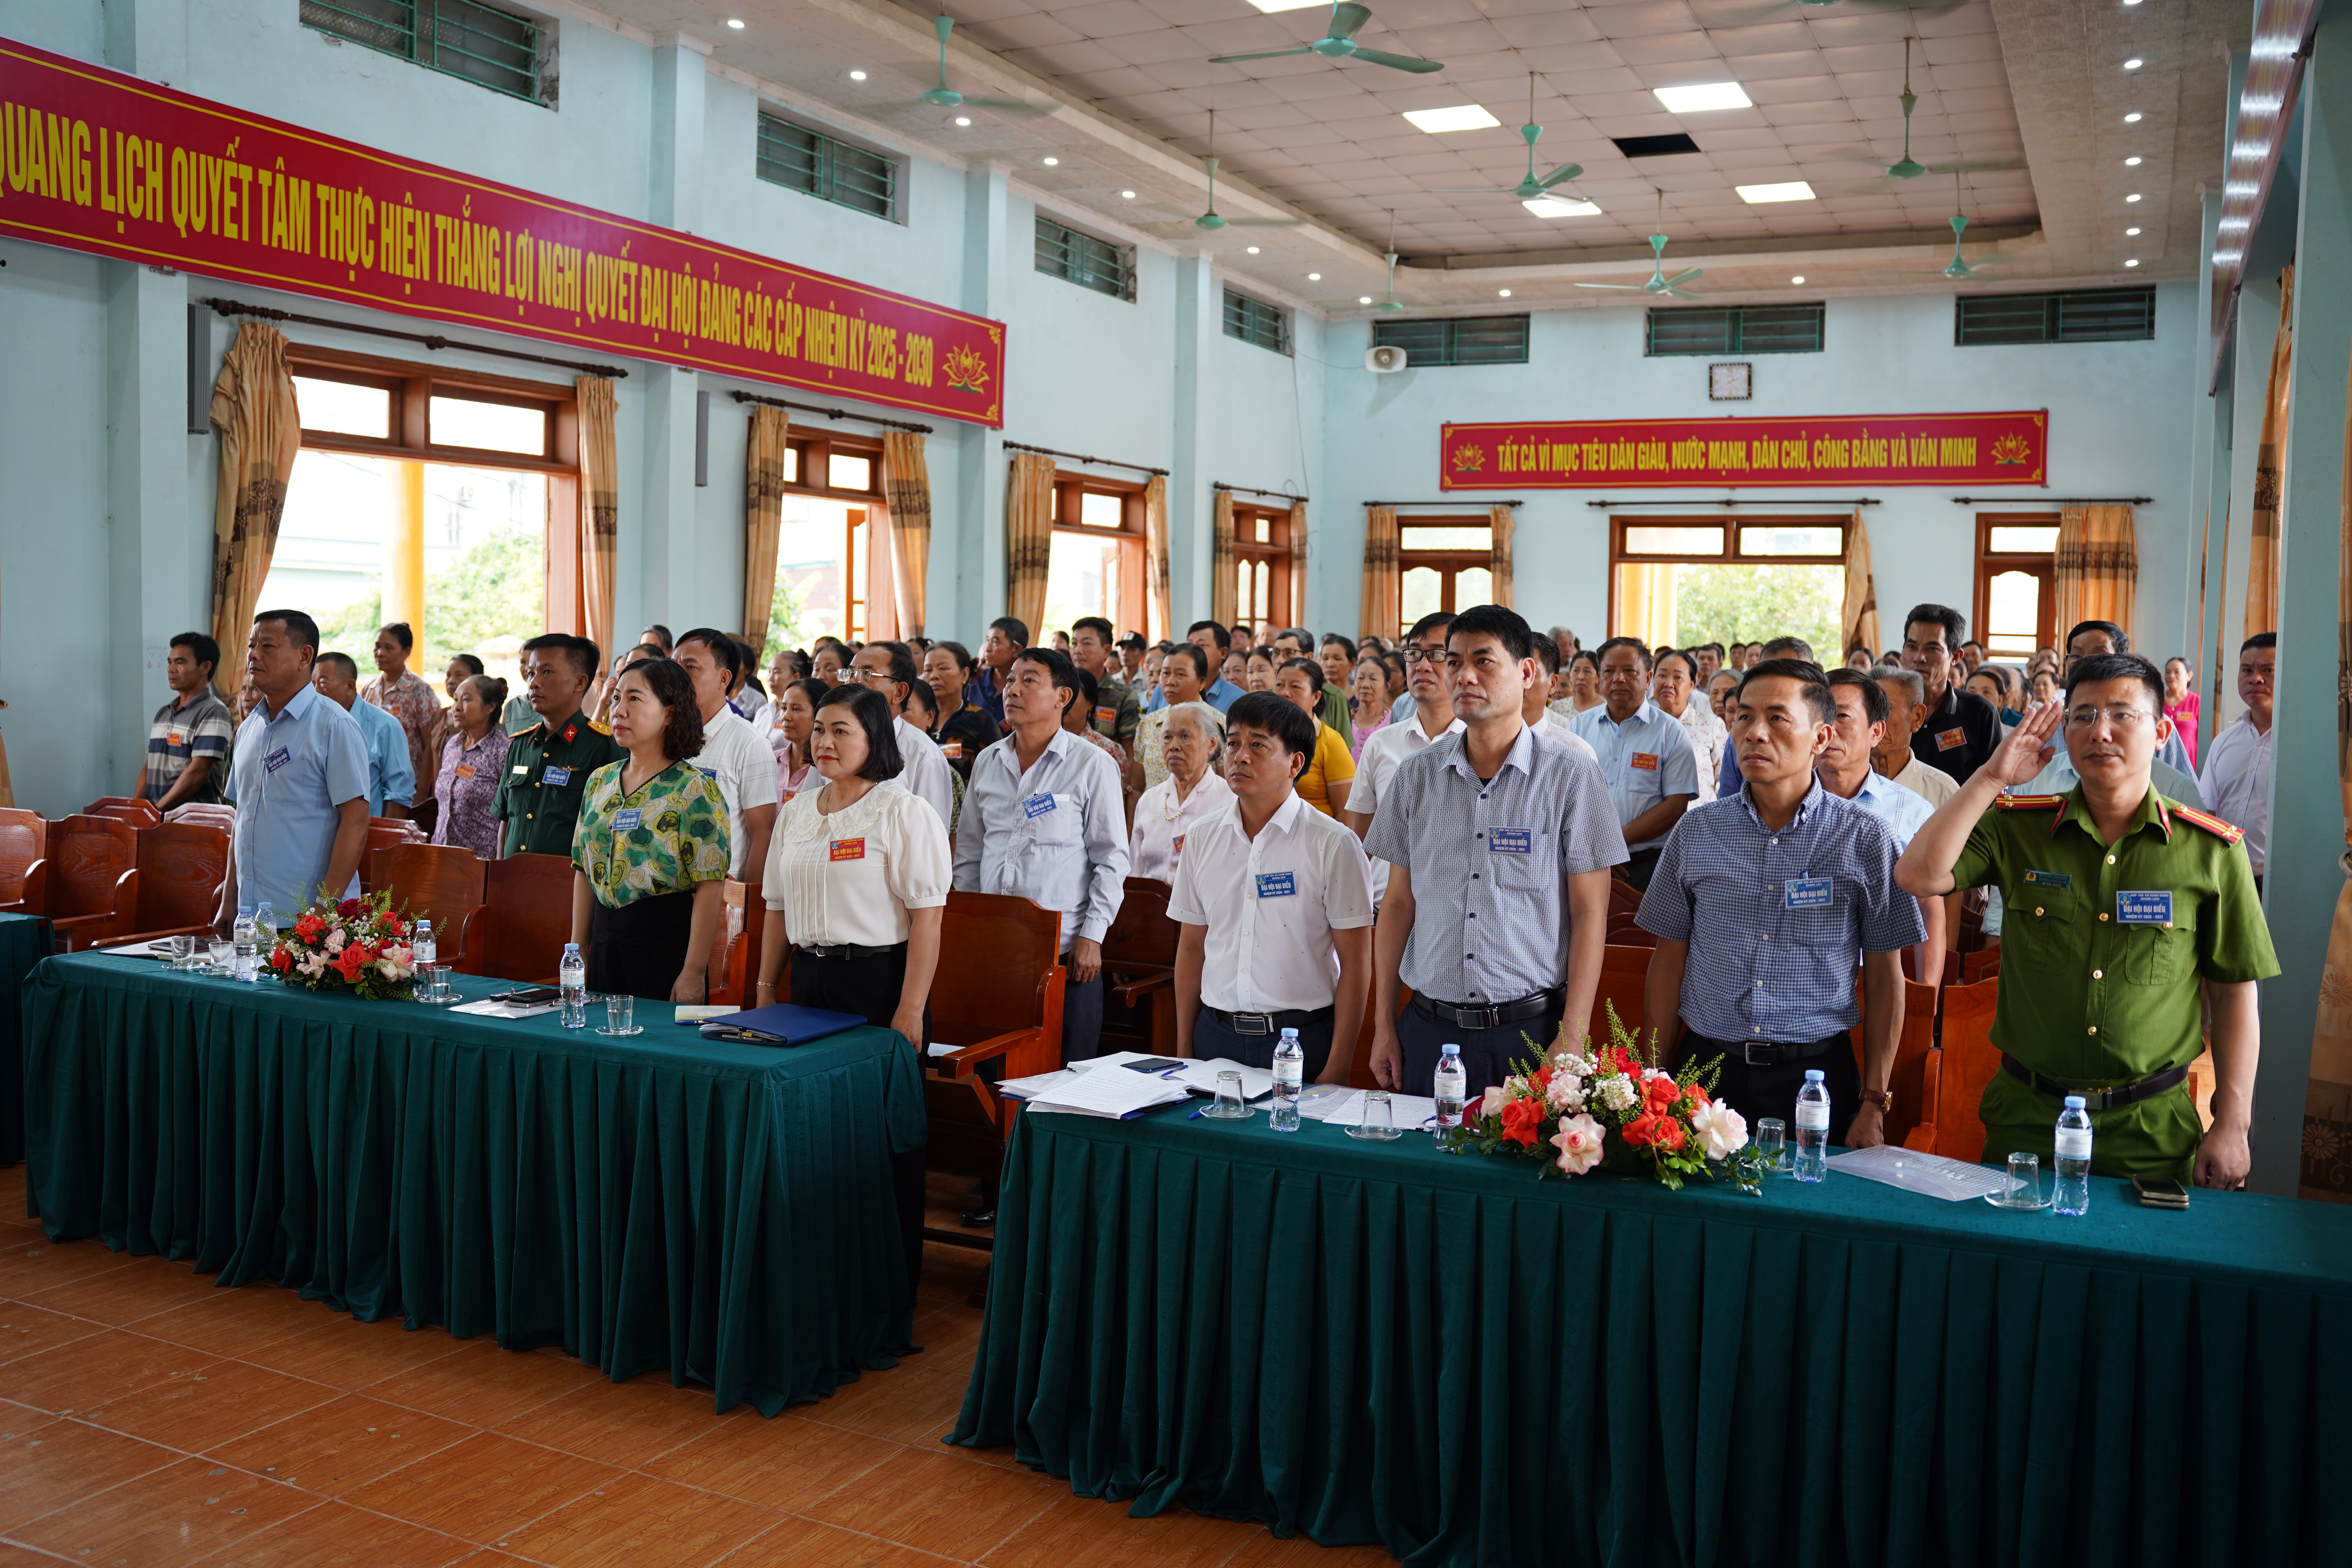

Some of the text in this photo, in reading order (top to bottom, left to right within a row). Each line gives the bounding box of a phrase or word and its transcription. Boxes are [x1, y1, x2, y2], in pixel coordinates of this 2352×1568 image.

[0, 102, 933, 387] UANG LỊCH QUYẾT TÂM THỰC HIỆN THẮNG LỢI NGHỊ QUYẾT ĐẠI HỘI ĐẢNG CÁC CẤP NHIỆM KỲ 2025 - 2030
[1498, 428, 1977, 477] TẤT CẢ VÌ MỤC TIÊU DÂN GIÀU, NƯỚC MẠNH, DÂN CHỦ, CÔNG BẰNG VÀ VĂN MINH
